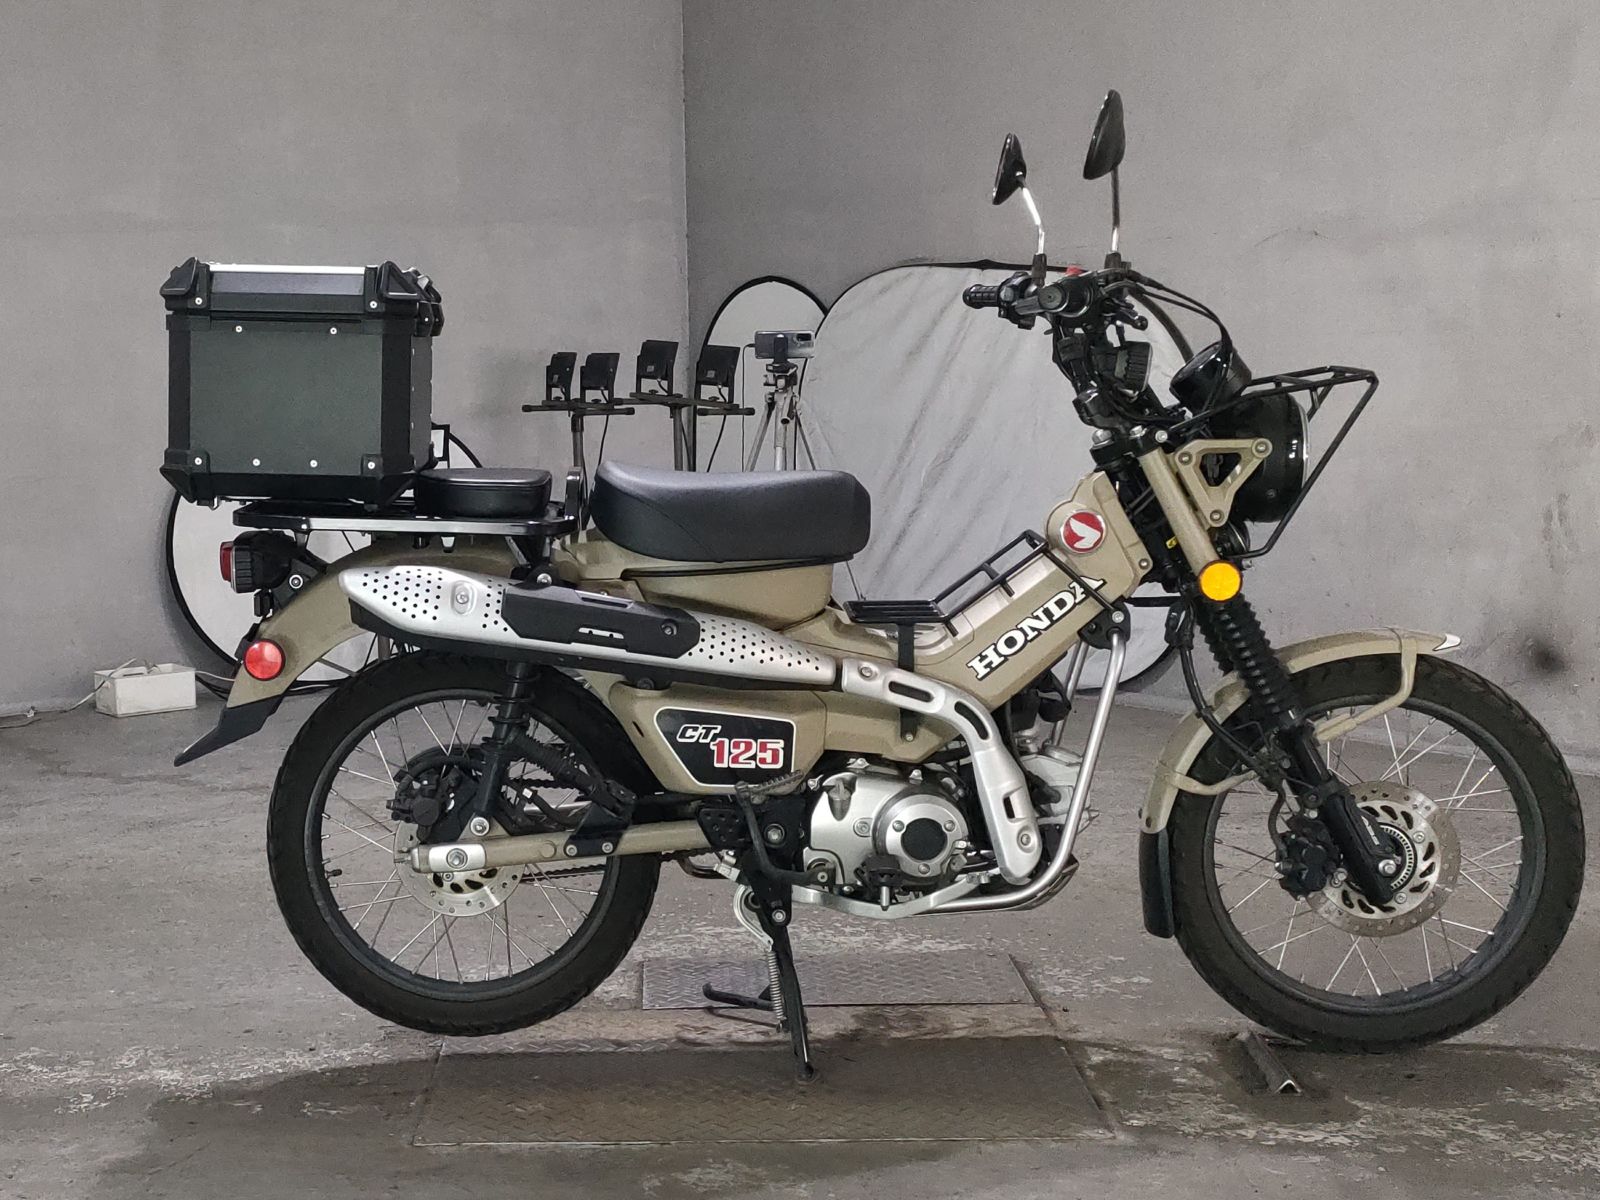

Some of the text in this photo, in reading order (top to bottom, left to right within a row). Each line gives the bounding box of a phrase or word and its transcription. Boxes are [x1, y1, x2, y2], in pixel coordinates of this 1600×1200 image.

[966, 576, 1106, 681] HONDA
[676, 724, 721, 742] CT
[710, 738, 784, 769] 125
